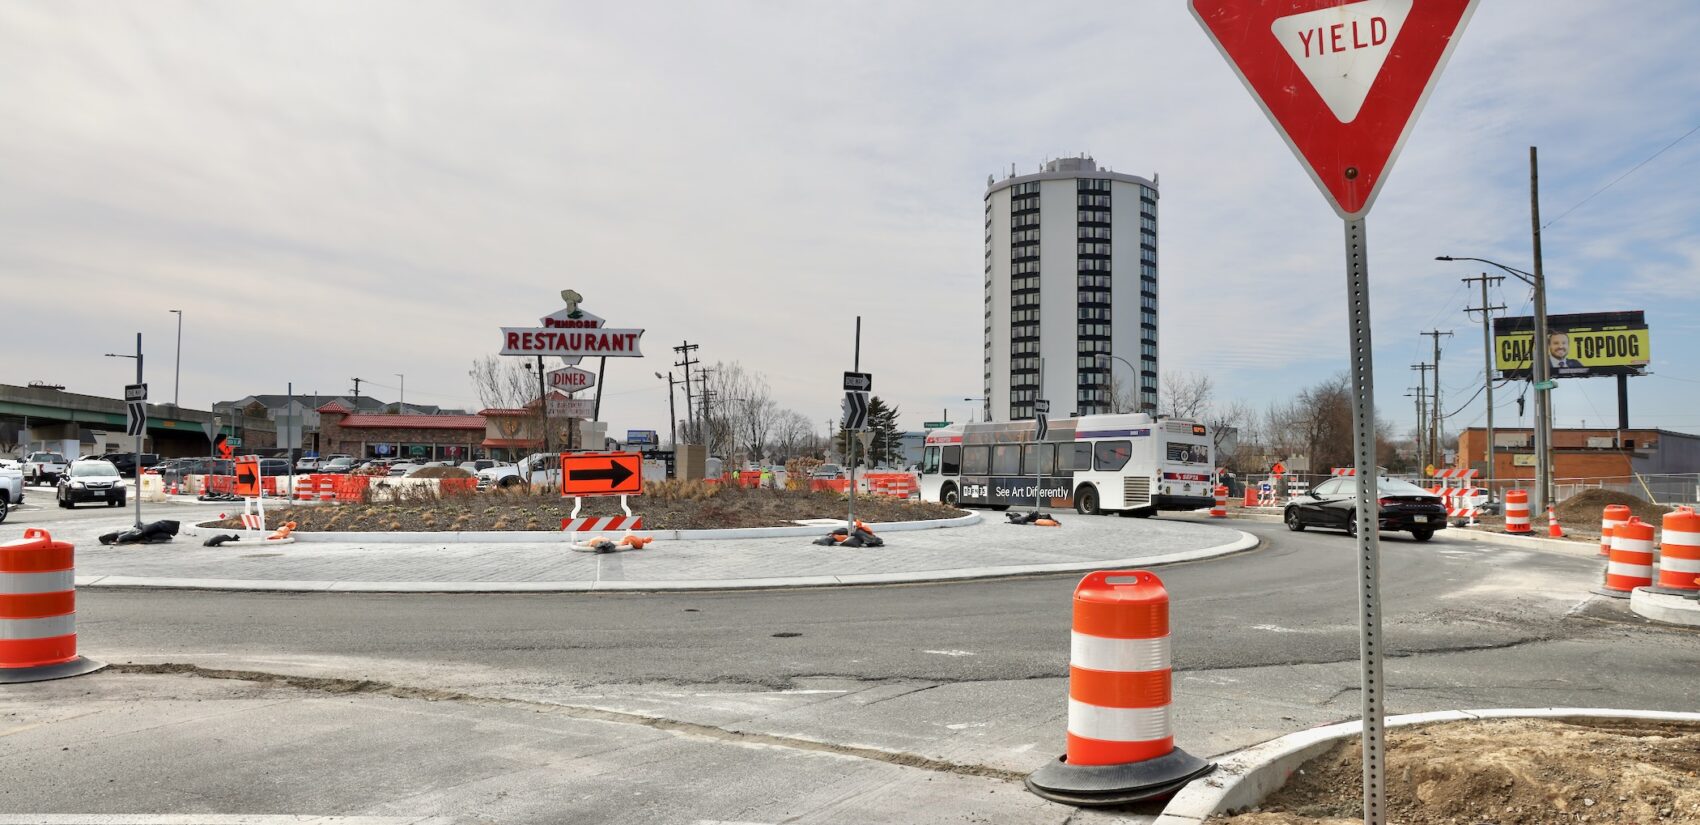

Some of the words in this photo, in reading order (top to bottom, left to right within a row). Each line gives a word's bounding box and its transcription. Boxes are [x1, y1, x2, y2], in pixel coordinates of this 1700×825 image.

[1298, 16, 1387, 58] YIELD
[545, 317, 598, 328] PENROSE
[507, 332, 638, 351] RESTAURANT
[1574, 334, 1639, 359] TOPDOG
[554, 373, 586, 386] DINER
[996, 486, 1010, 497] See
[1011, 486, 1024, 497] Art
[1026, 486, 1069, 500] Diferently
